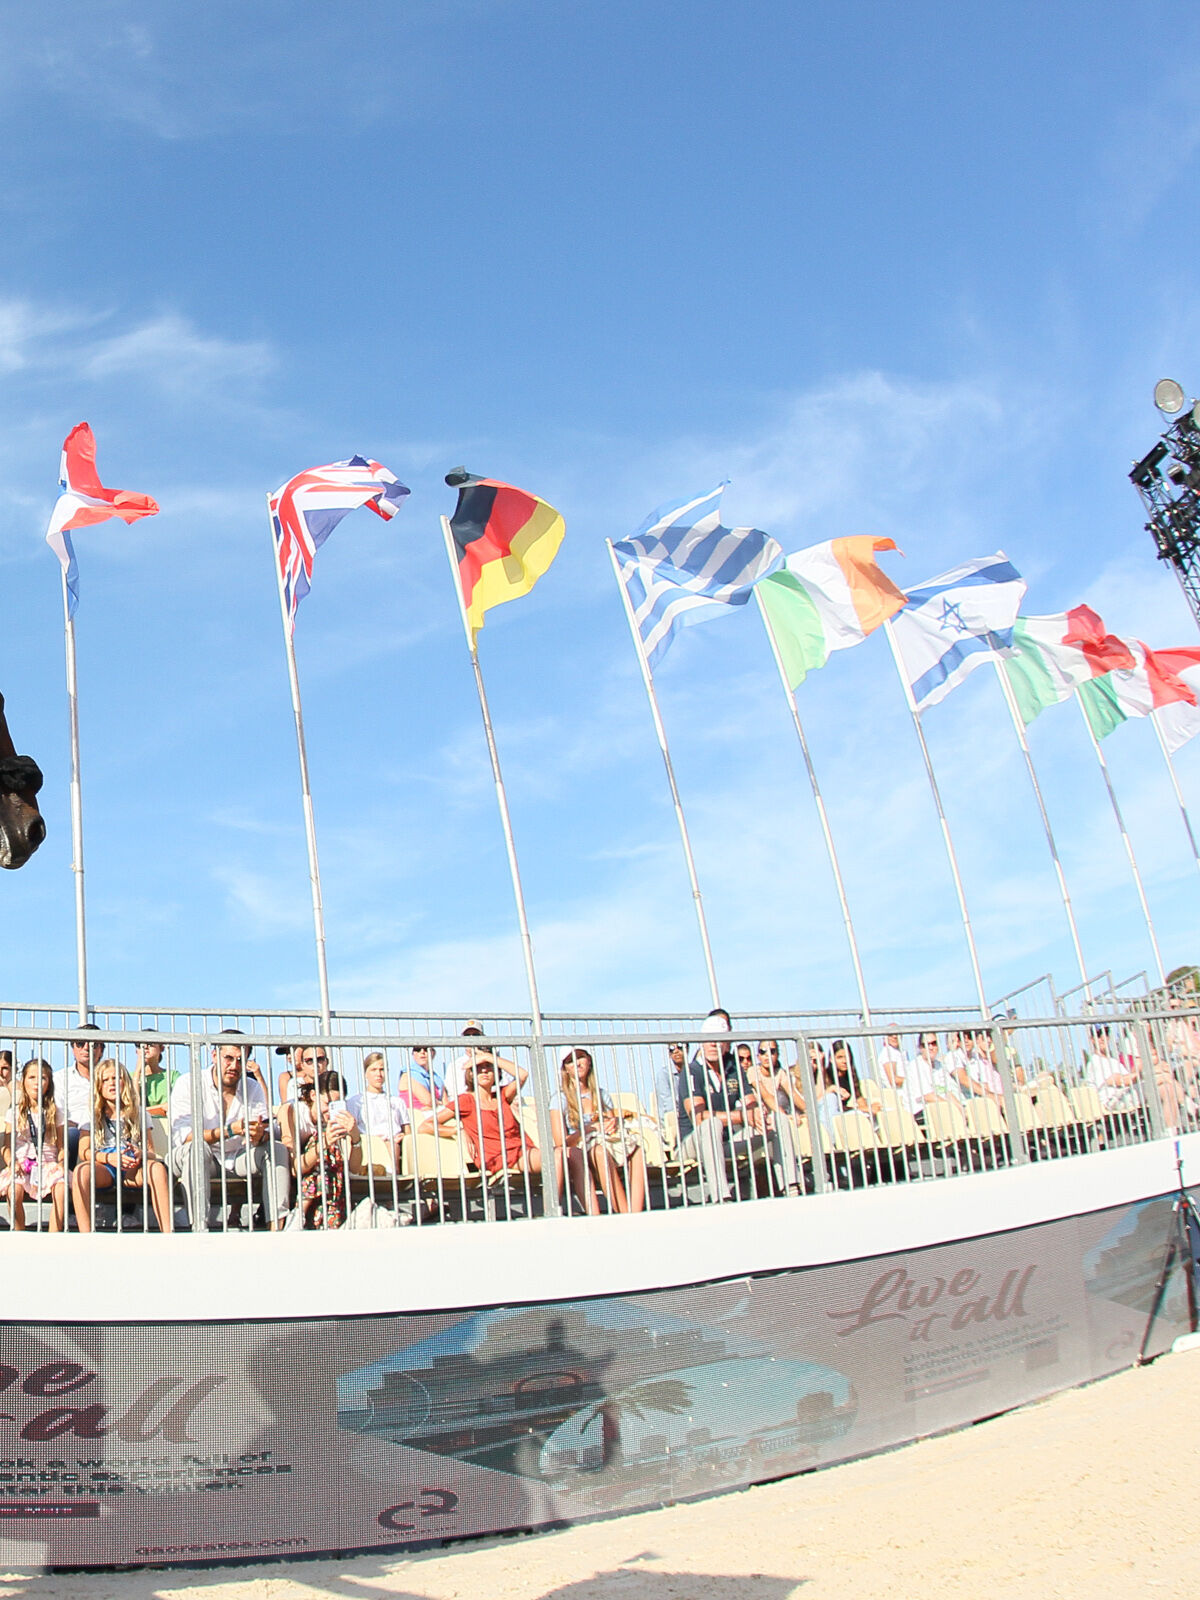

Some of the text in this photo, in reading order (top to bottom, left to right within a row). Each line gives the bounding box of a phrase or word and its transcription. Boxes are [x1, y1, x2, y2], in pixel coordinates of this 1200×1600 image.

[826, 1268, 981, 1337] Live
[950, 1264, 1038, 1331] all
[19, 1375, 228, 1444] all
